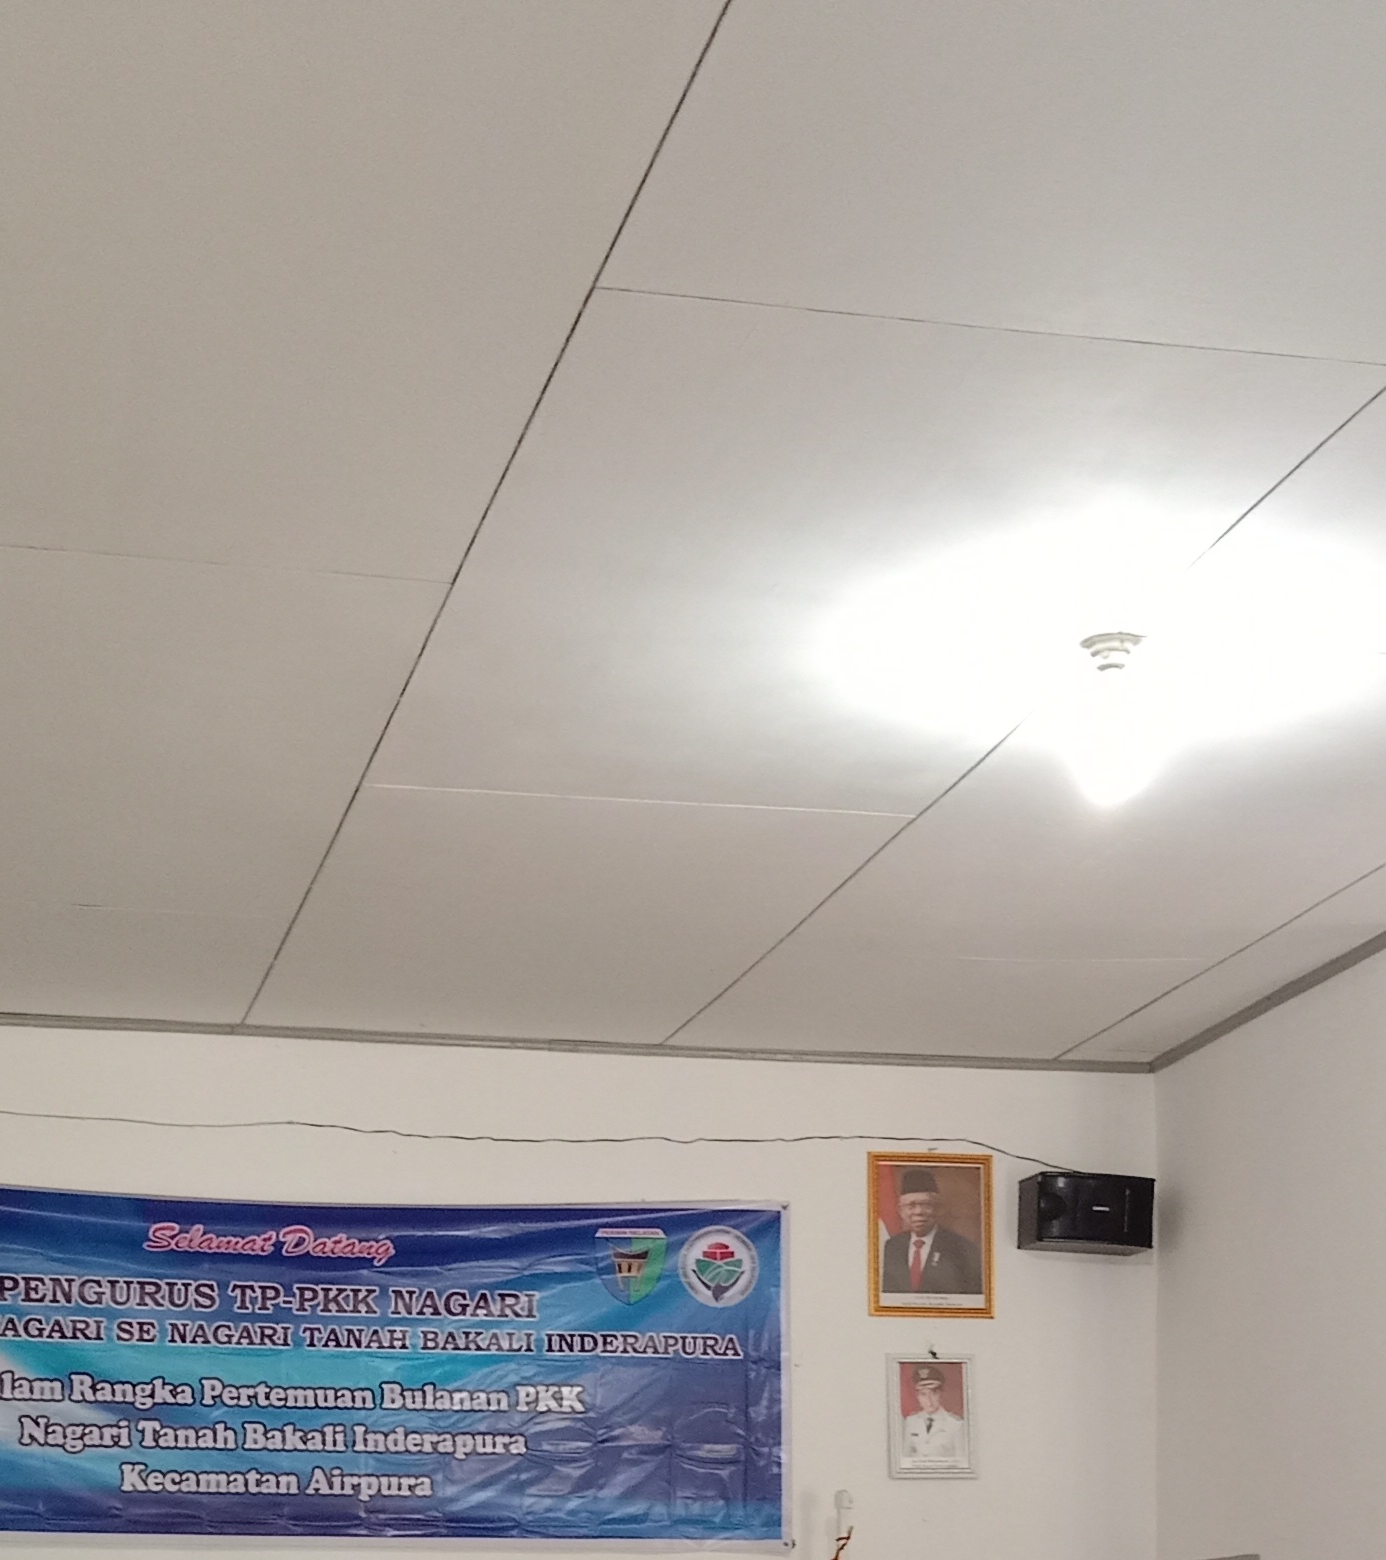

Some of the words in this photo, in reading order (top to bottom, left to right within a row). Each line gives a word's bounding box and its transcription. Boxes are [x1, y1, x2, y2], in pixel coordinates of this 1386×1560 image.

[144, 1222, 276, 1254] Selamat
[279, 1225, 395, 1266] Datang
[230, 1282, 379, 1316] TP-PKK
[390, 1287, 538, 1320] NAGARI
[116, 1320, 157, 1344] SE
[168, 1321, 293, 1348] NAGARI
[302, 1325, 408, 1351] TANAH
[420, 1329, 534, 1354] BAKALI
[544, 1332, 744, 1359] INDERAPURA
[69, 1372, 194, 1410] Rangka
[200, 1377, 375, 1410] Pertemuan
[379, 1381, 510, 1412] Bulanan
[515, 1384, 586, 1413] PKK
[19, 1415, 132, 1453] Nagari
[137, 1417, 238, 1450] Tanah
[242, 1421, 348, 1452] Bakali
[351, 1424, 527, 1460] Inderapura
[119, 1462, 299, 1494] Kecamatan
[305, 1466, 433, 1501] Airpura
